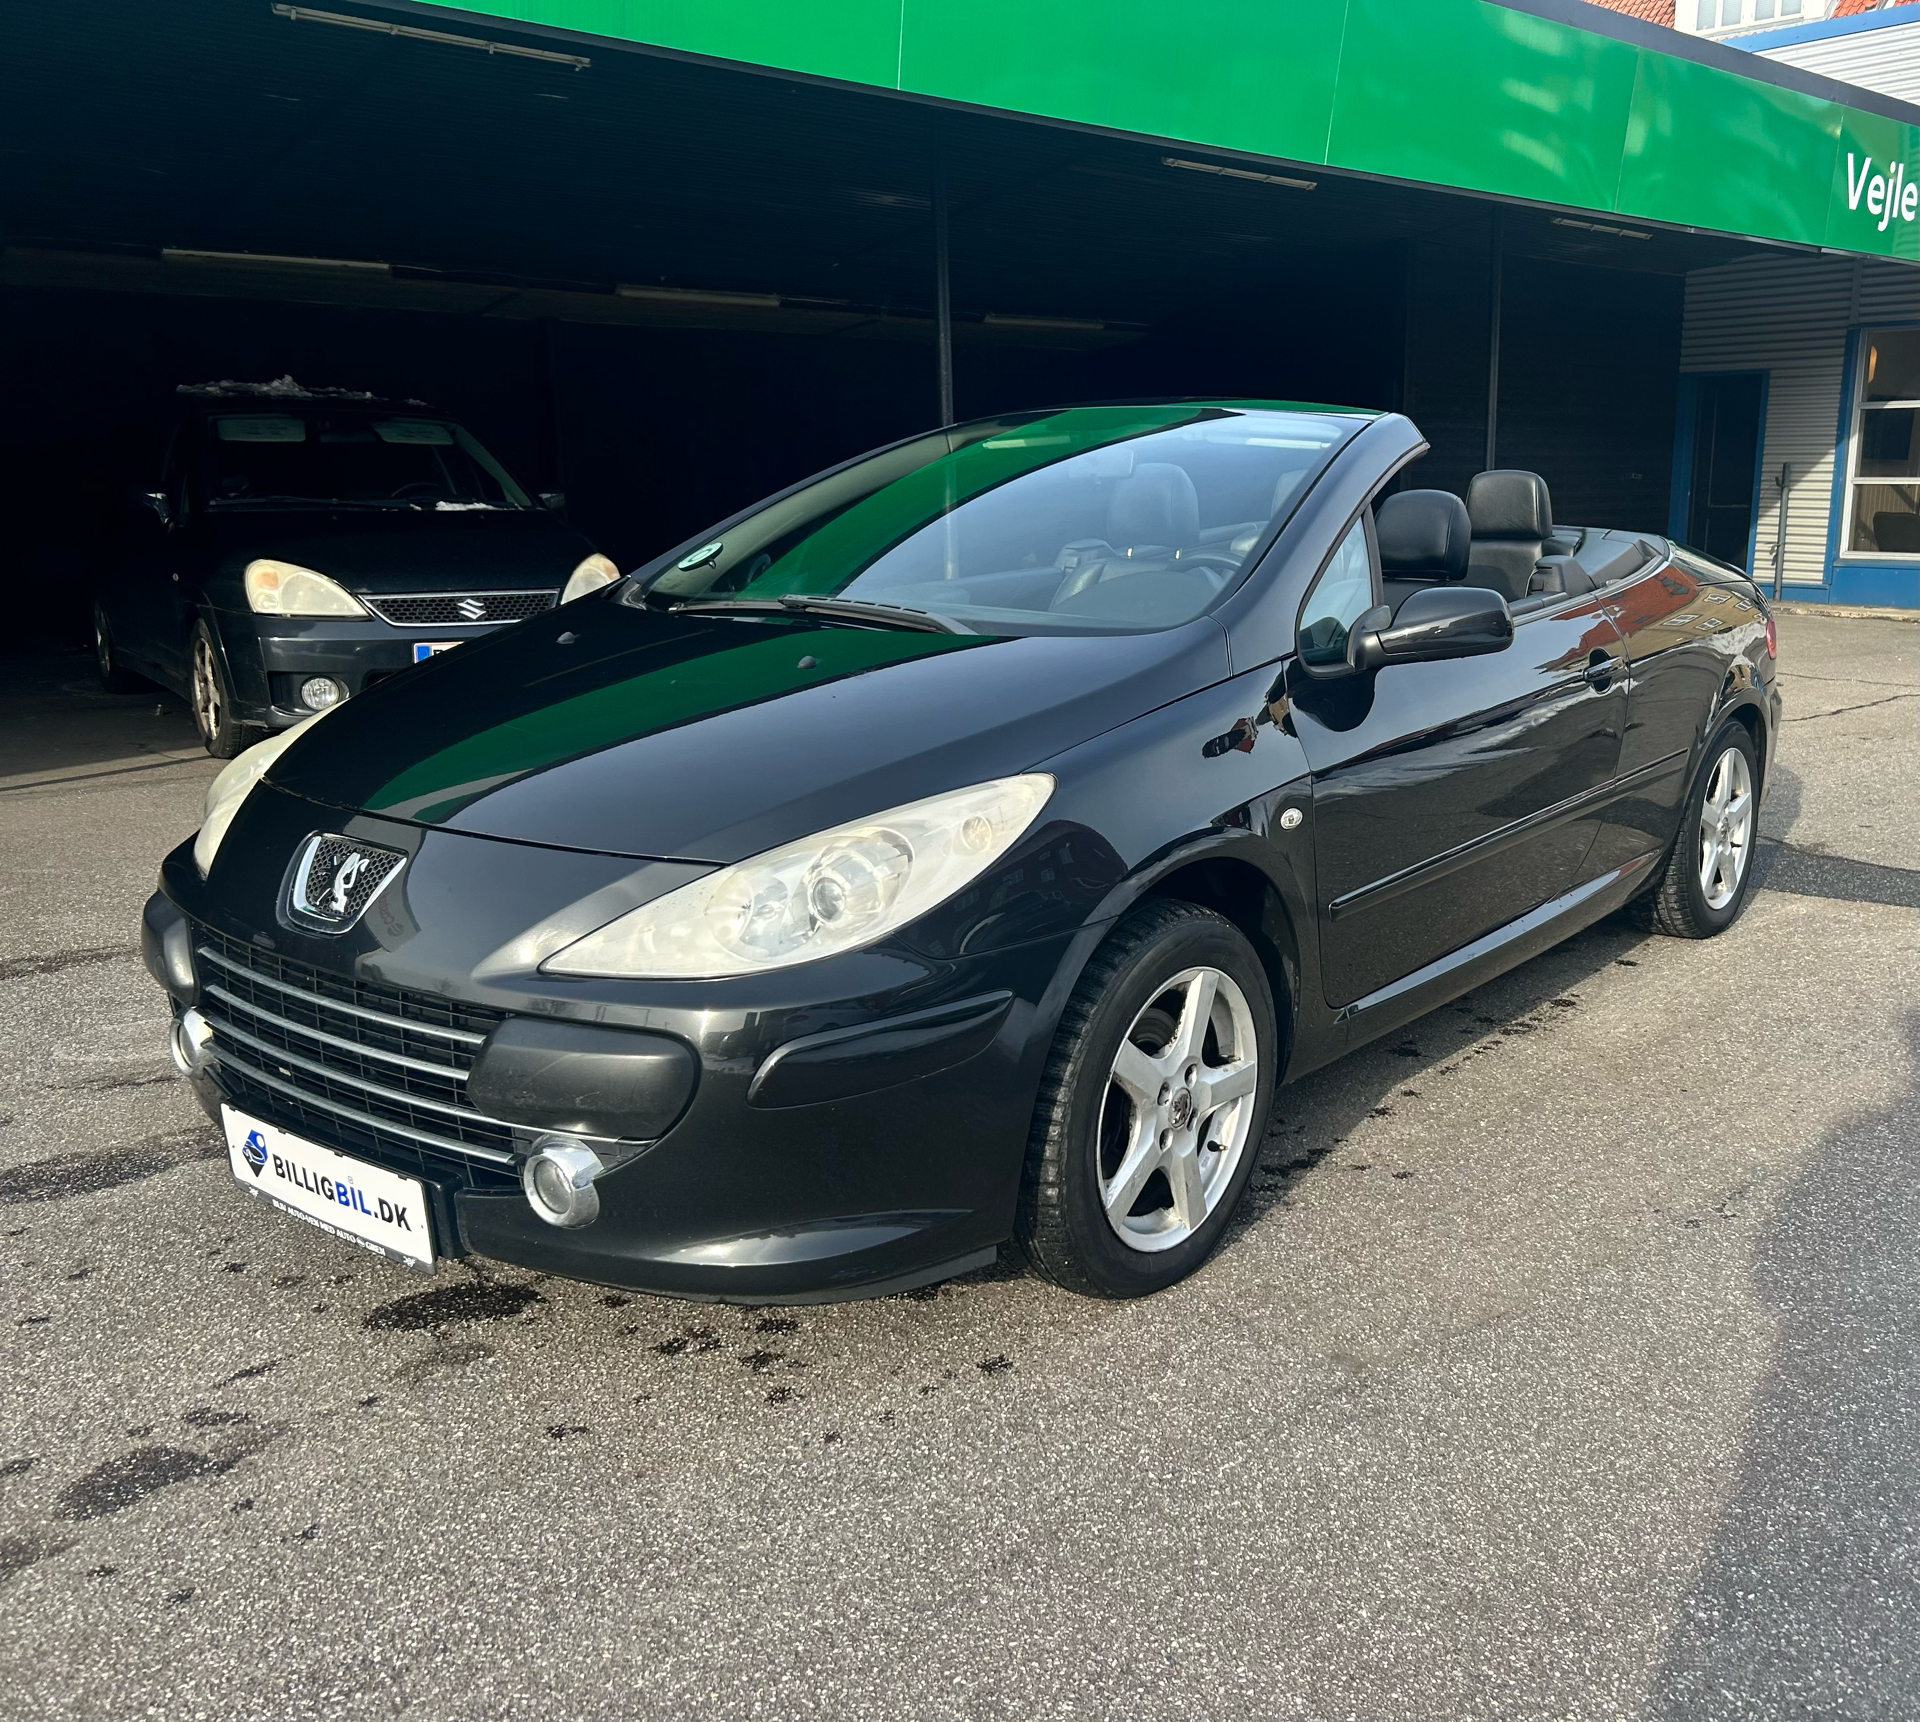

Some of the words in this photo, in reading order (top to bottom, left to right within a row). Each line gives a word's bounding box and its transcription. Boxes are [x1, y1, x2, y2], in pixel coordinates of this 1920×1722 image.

[1847, 152, 1918, 232] Vejle
[272, 1153, 412, 1232] BILLIGBIL.DK
[319, 1221, 336, 1235] MED
[336, 1229, 356, 1244] AUTO
